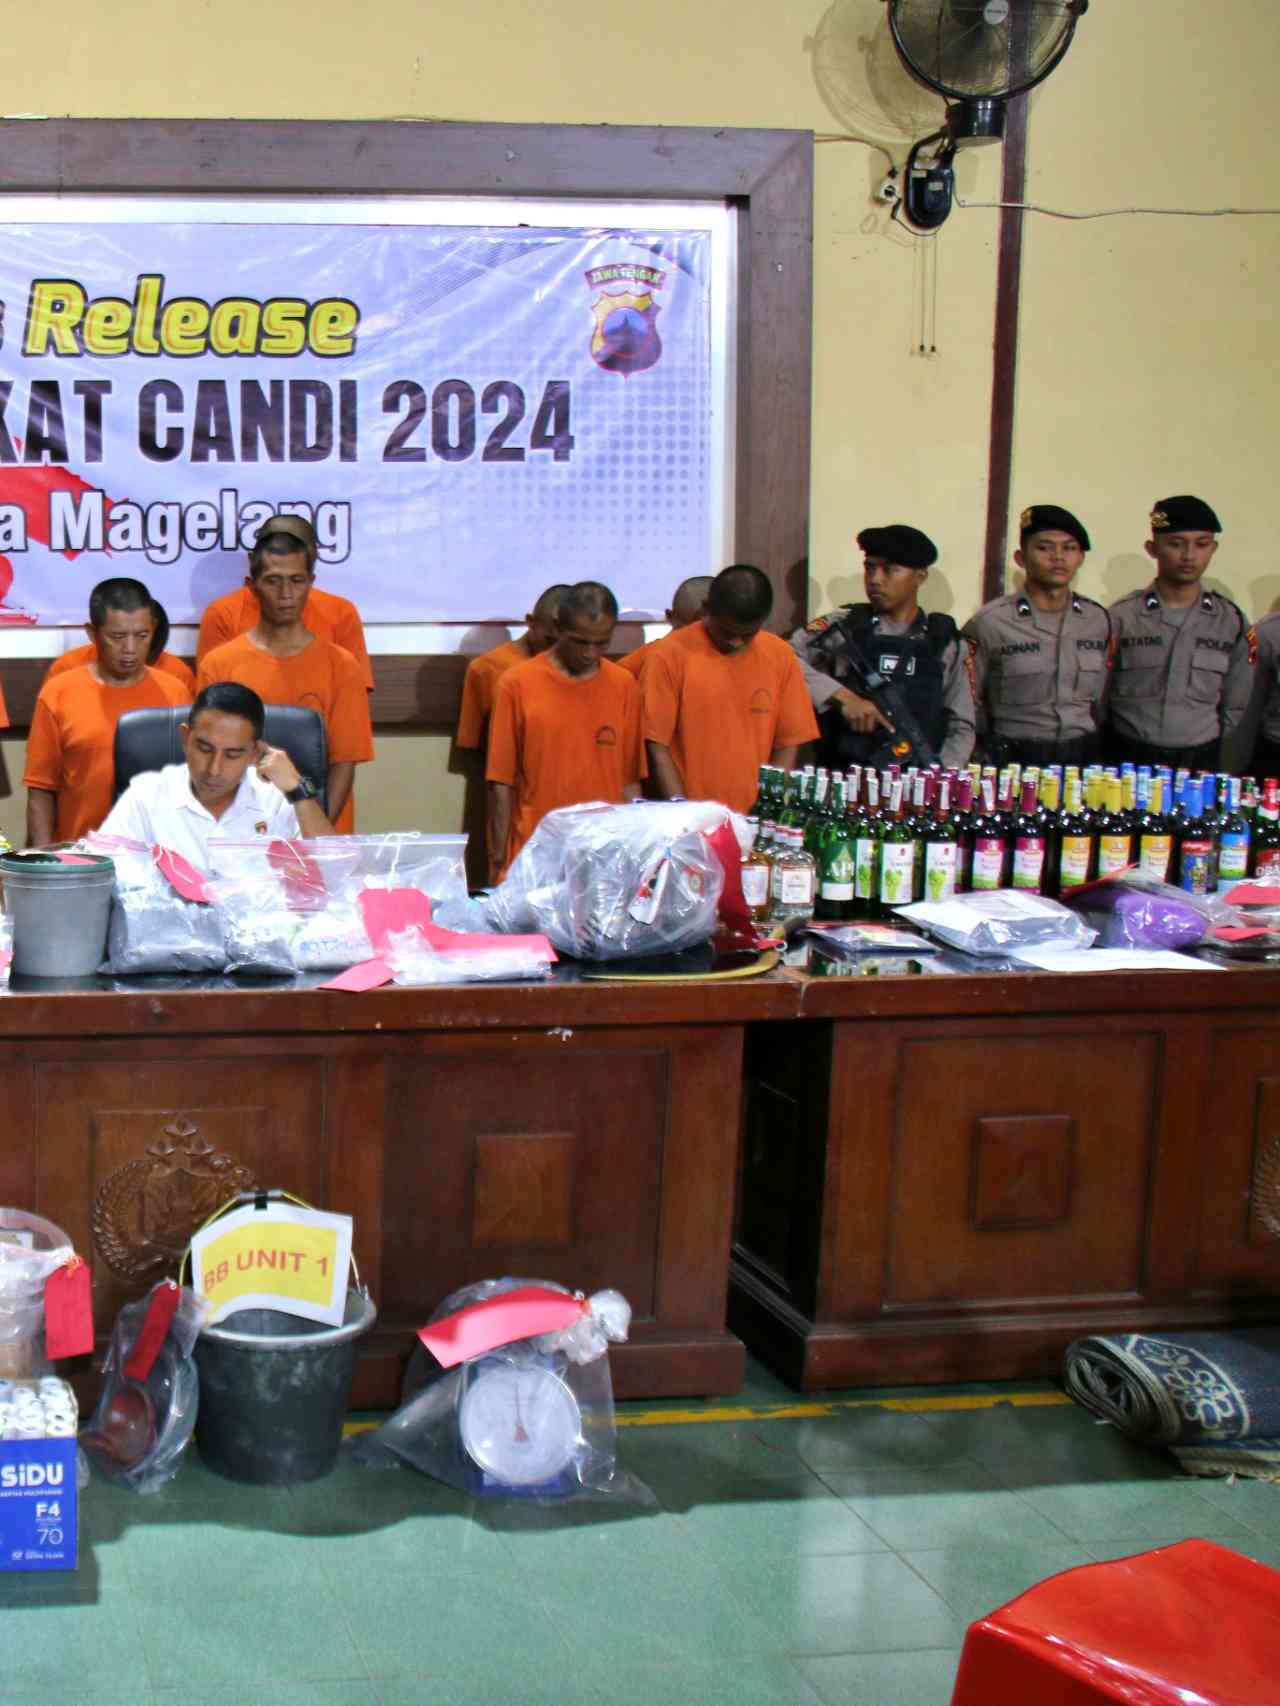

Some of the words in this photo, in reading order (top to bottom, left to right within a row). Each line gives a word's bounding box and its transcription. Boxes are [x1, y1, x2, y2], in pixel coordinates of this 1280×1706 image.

[22, 273, 361, 358] Release
[137, 378, 359, 464] CANDI
[381, 378, 575, 463] 2024
[236, 1249, 308, 1273] UNIT
[316, 1256, 329, 1278] 1
[35, 1502, 61, 1518] F4
[37, 1528, 64, 1545] 70
